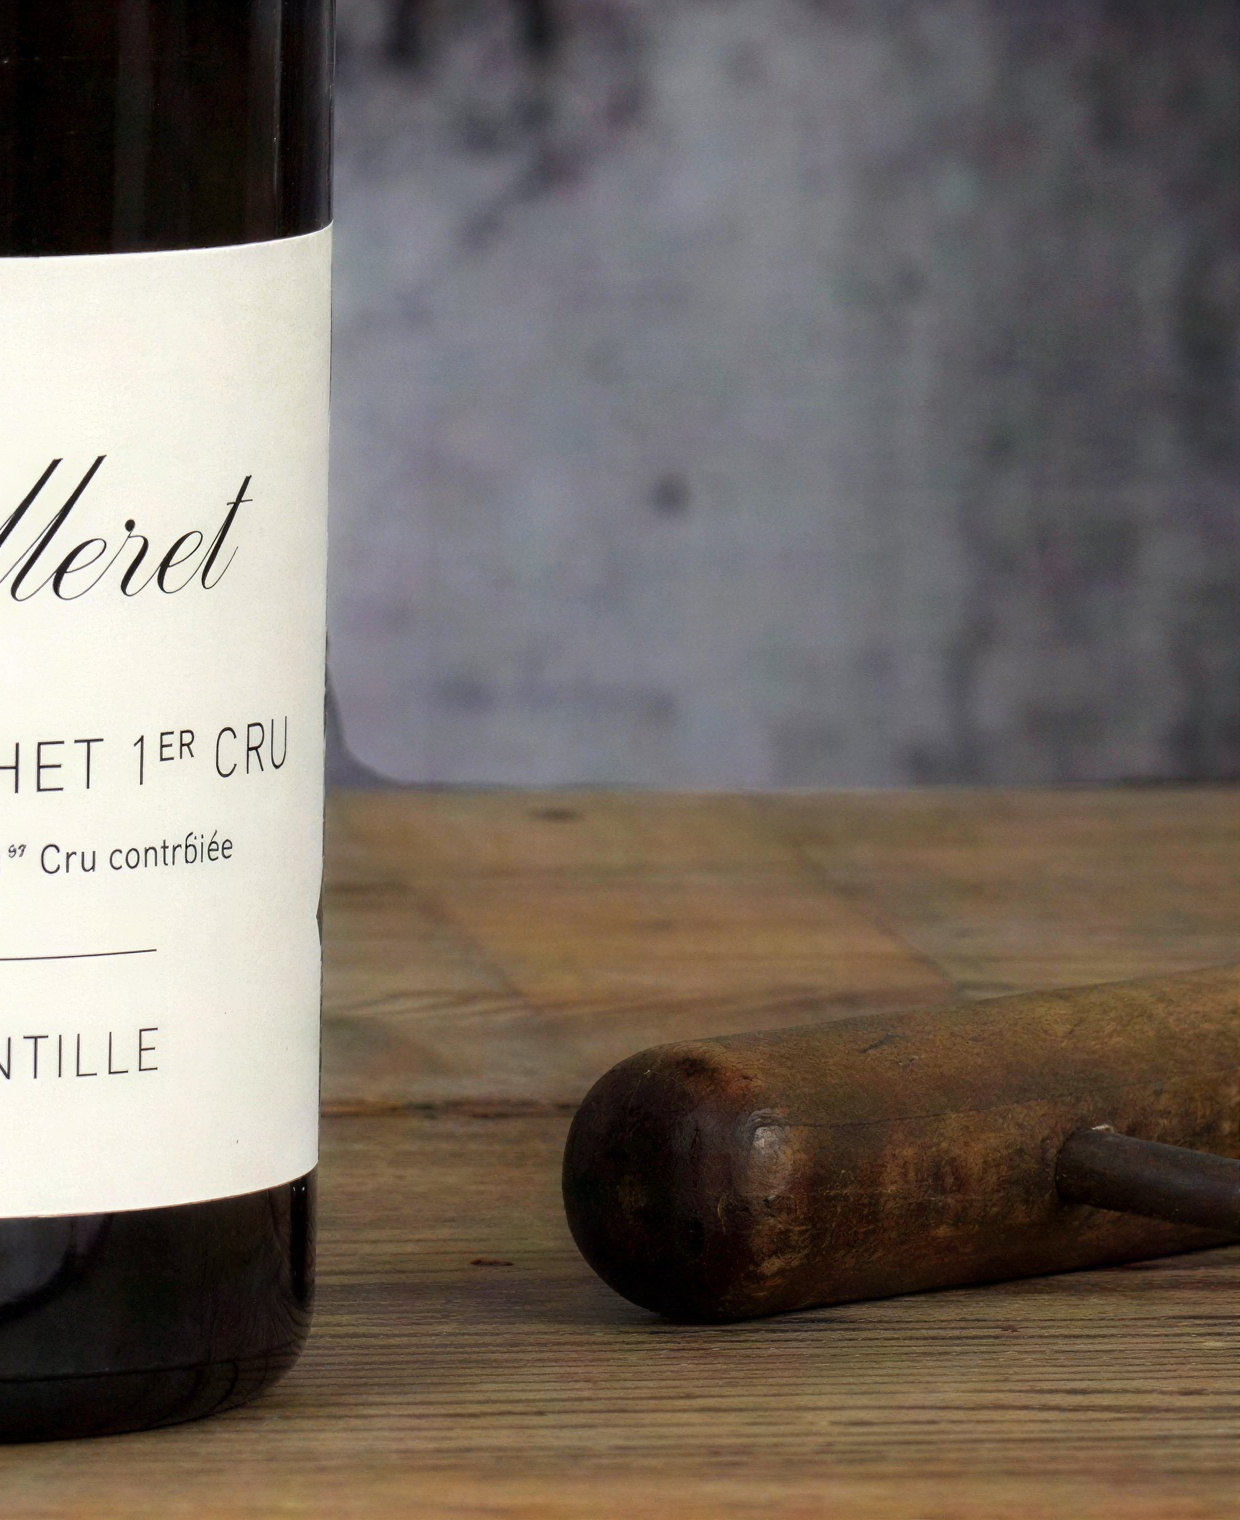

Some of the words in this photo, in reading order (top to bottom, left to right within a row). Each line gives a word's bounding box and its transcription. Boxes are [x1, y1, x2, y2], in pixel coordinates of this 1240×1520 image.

[133, 729, 195, 786] 1ER
[215, 715, 288, 779] CRU
[40, 843, 96, 875] Cru
